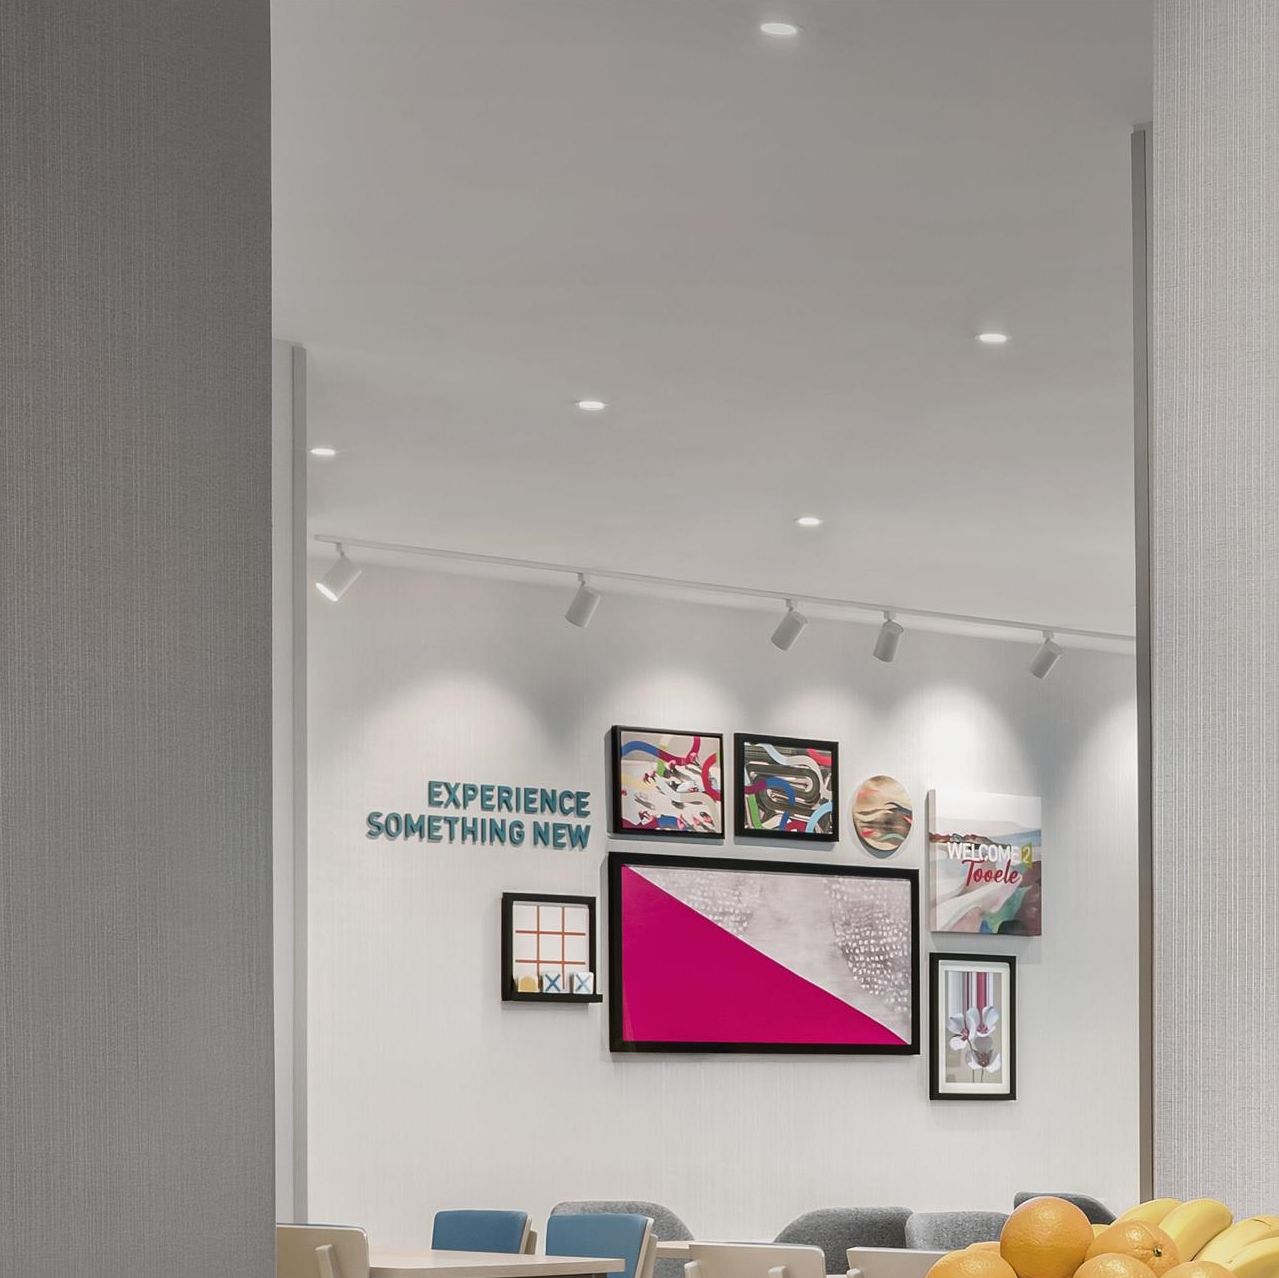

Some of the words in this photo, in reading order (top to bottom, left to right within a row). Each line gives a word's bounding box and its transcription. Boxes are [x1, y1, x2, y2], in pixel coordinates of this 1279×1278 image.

[428, 780, 591, 818] EXPERIENCE
[366, 811, 525, 848] SOMETHING
[532, 820, 591, 850] NEW
[947, 841, 1020, 864] WELCOME
[961, 859, 1021, 887] Tooele
